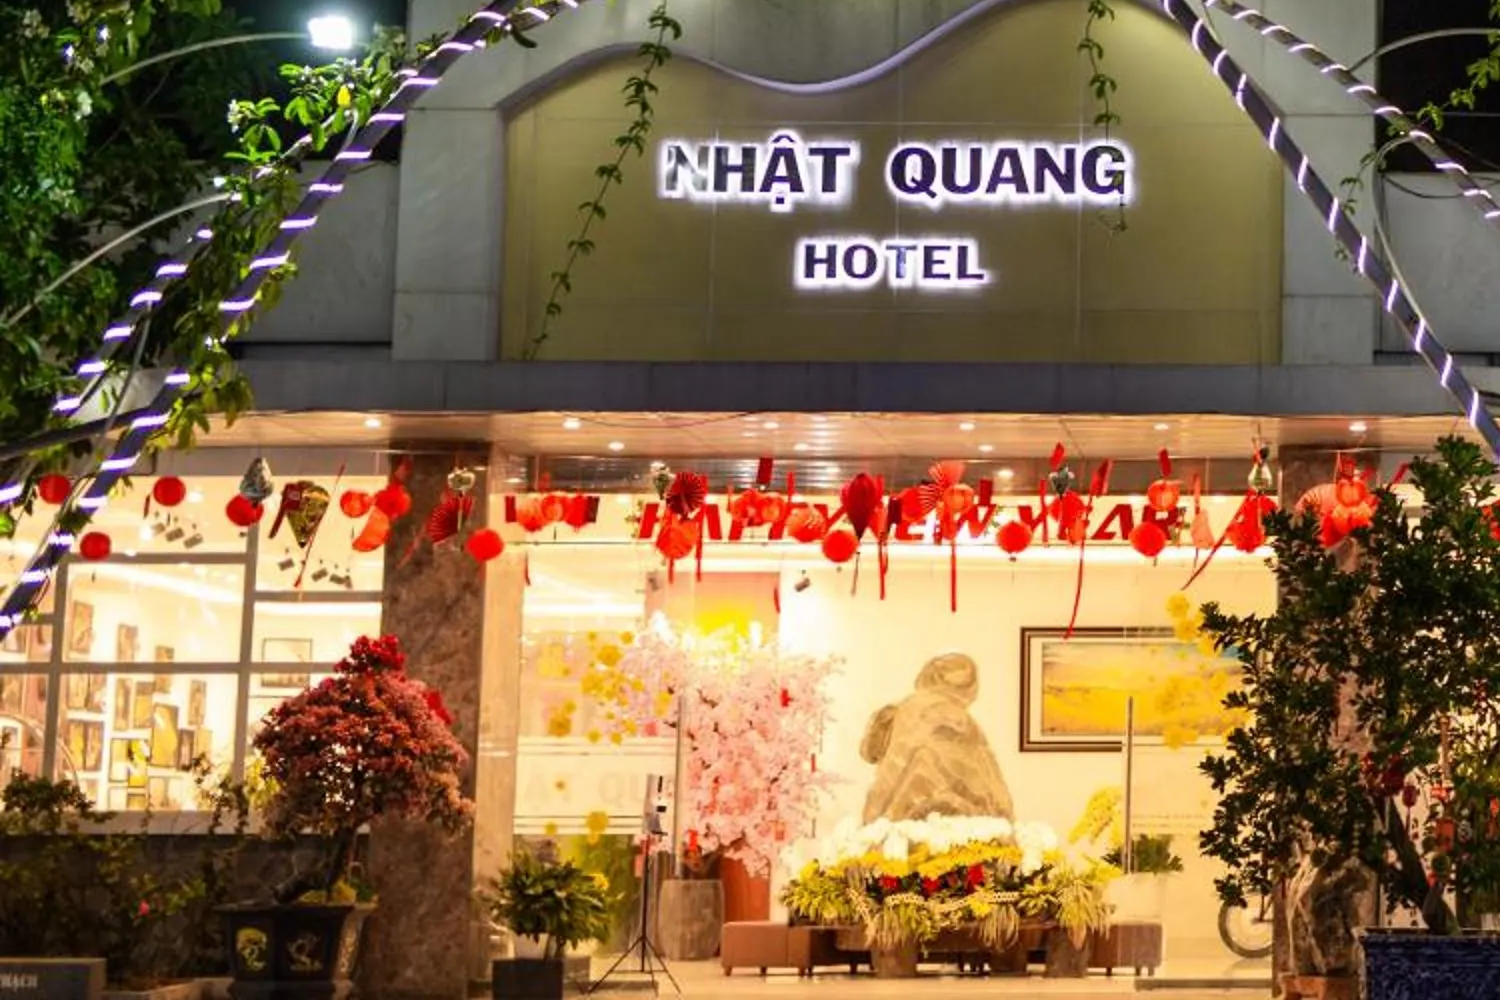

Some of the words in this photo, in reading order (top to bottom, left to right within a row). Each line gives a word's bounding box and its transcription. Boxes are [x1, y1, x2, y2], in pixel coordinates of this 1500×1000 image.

[662, 132, 852, 206] NHẬT
[887, 143, 1128, 199] QUANG
[799, 242, 986, 282] HOTEL
